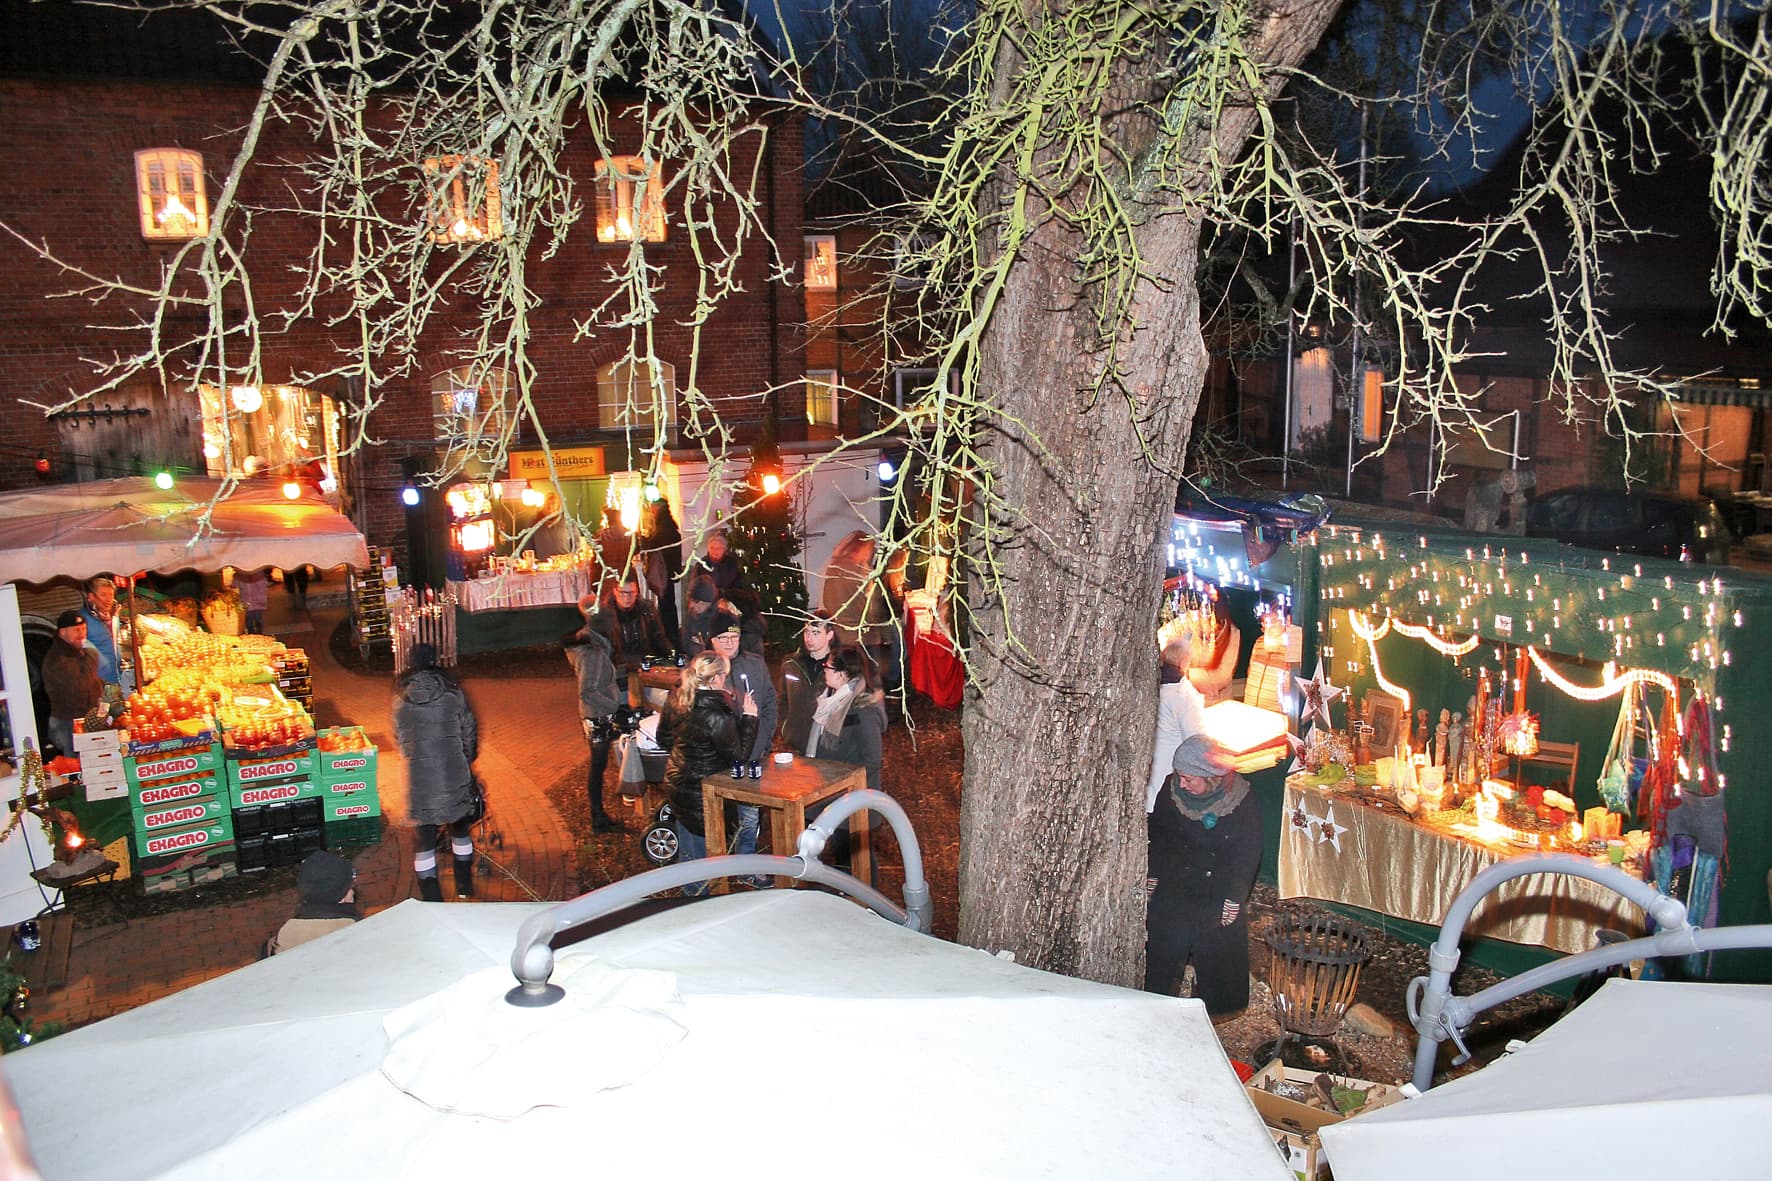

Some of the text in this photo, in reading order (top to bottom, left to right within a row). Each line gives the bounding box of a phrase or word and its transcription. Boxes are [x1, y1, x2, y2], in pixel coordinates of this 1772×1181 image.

[138, 758, 198, 779] EXAGRO
[241, 761, 297, 780] EXAGRO
[333, 759, 366, 769] EXAGRO
[142, 782, 202, 803] EXAGRO
[243, 785, 299, 804] EXAGRO
[333, 782, 366, 792] EXAGRO
[146, 805, 205, 827] EXAGRO
[337, 806, 369, 815] EXAGRO
[149, 831, 207, 854] EXAGRO
